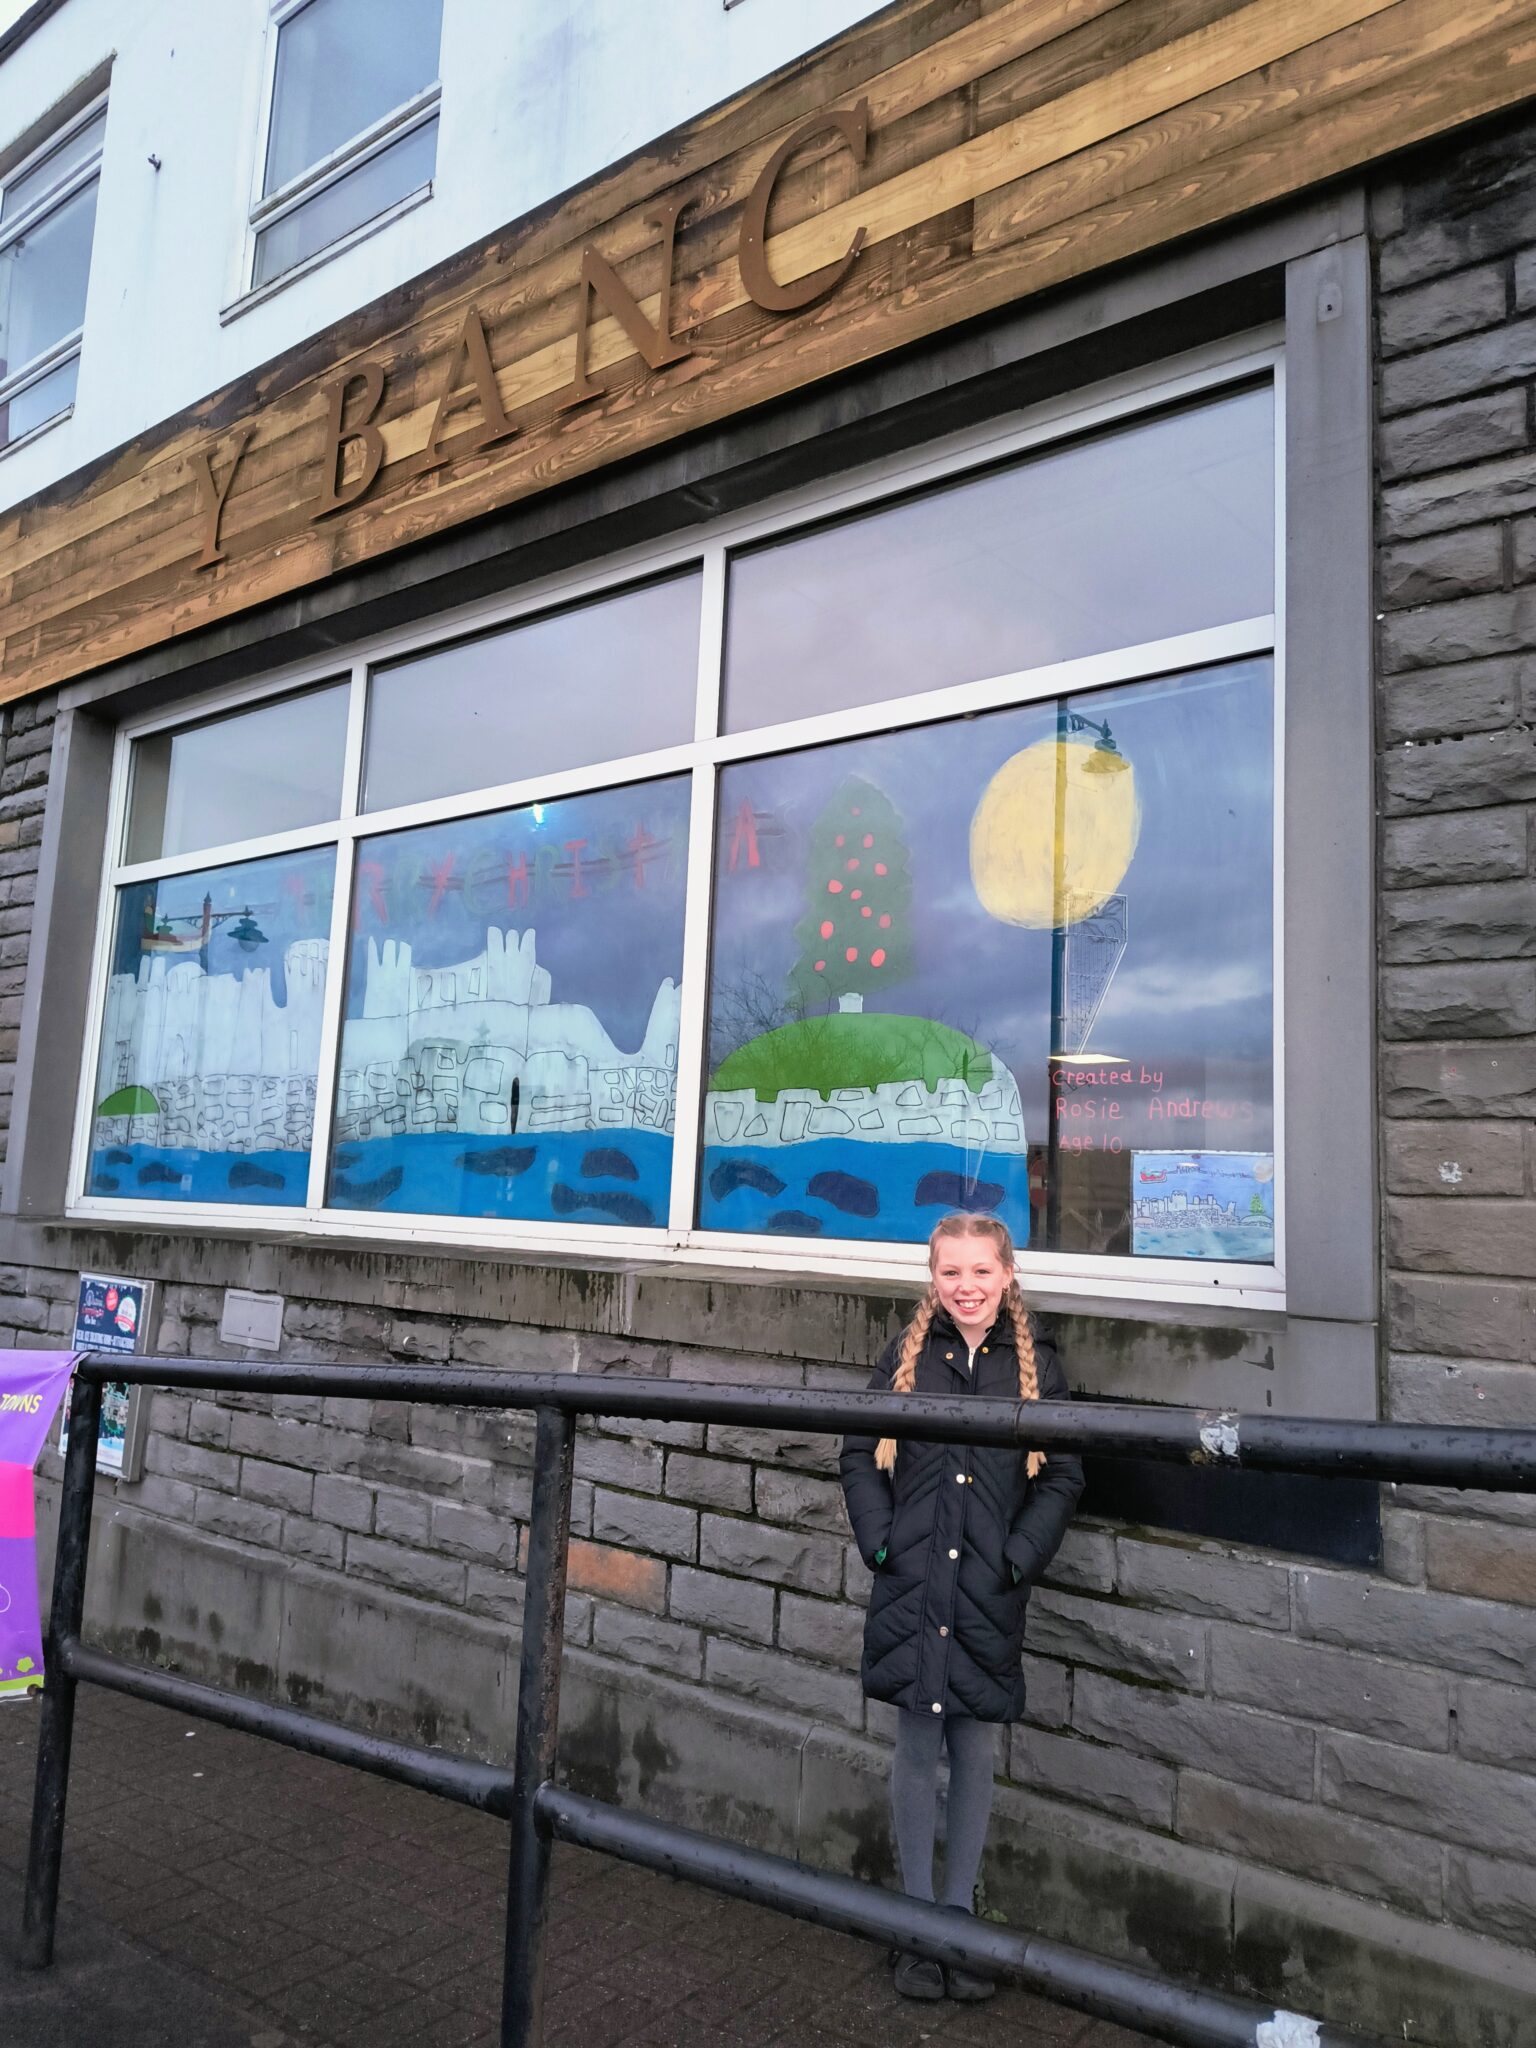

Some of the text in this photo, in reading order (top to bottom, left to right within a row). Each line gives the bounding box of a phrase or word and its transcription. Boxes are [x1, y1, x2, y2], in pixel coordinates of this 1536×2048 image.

[187, 99, 868, 573] Y BANC
[1052, 1066, 1163, 1092] Created by
[1056, 1097, 1253, 1121] Rosie Andrews
[1059, 1133, 1123, 1156] Age 10
